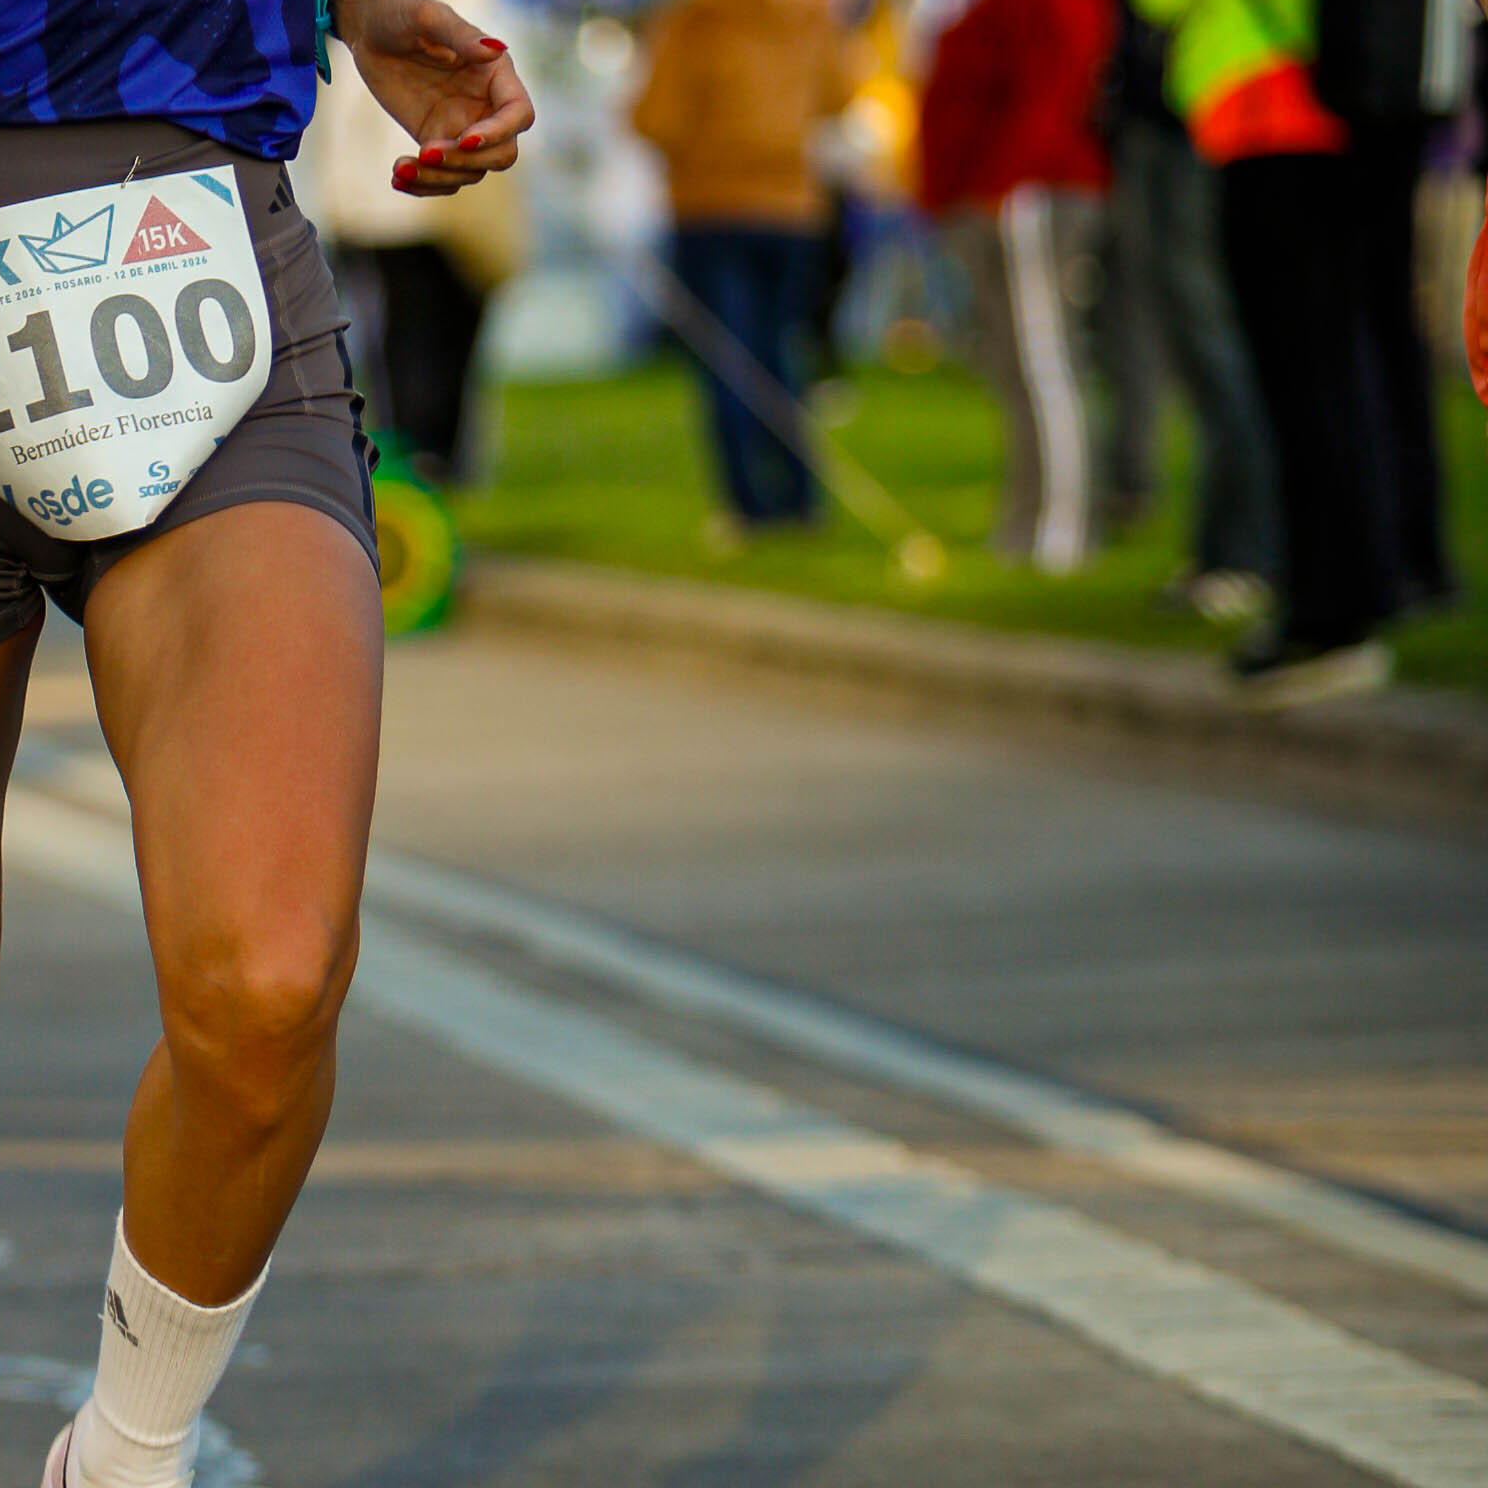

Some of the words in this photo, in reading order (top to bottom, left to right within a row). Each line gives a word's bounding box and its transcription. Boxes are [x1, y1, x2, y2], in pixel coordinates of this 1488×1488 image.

[138, 222, 187, 252] 15K
[16, 286, 42, 300] 2026
[55, 275, 102, 290] ROSARIO
[114, 271, 127, 280] 12
[130, 267, 144, 278] DE
[148, 262, 179, 275] ABRIL
[182, 256, 208, 268] 2026
[11, 423, 113, 465] Bermúdez
[117, 401, 214, 435] Florencia
[27, 475, 114, 526] osde
